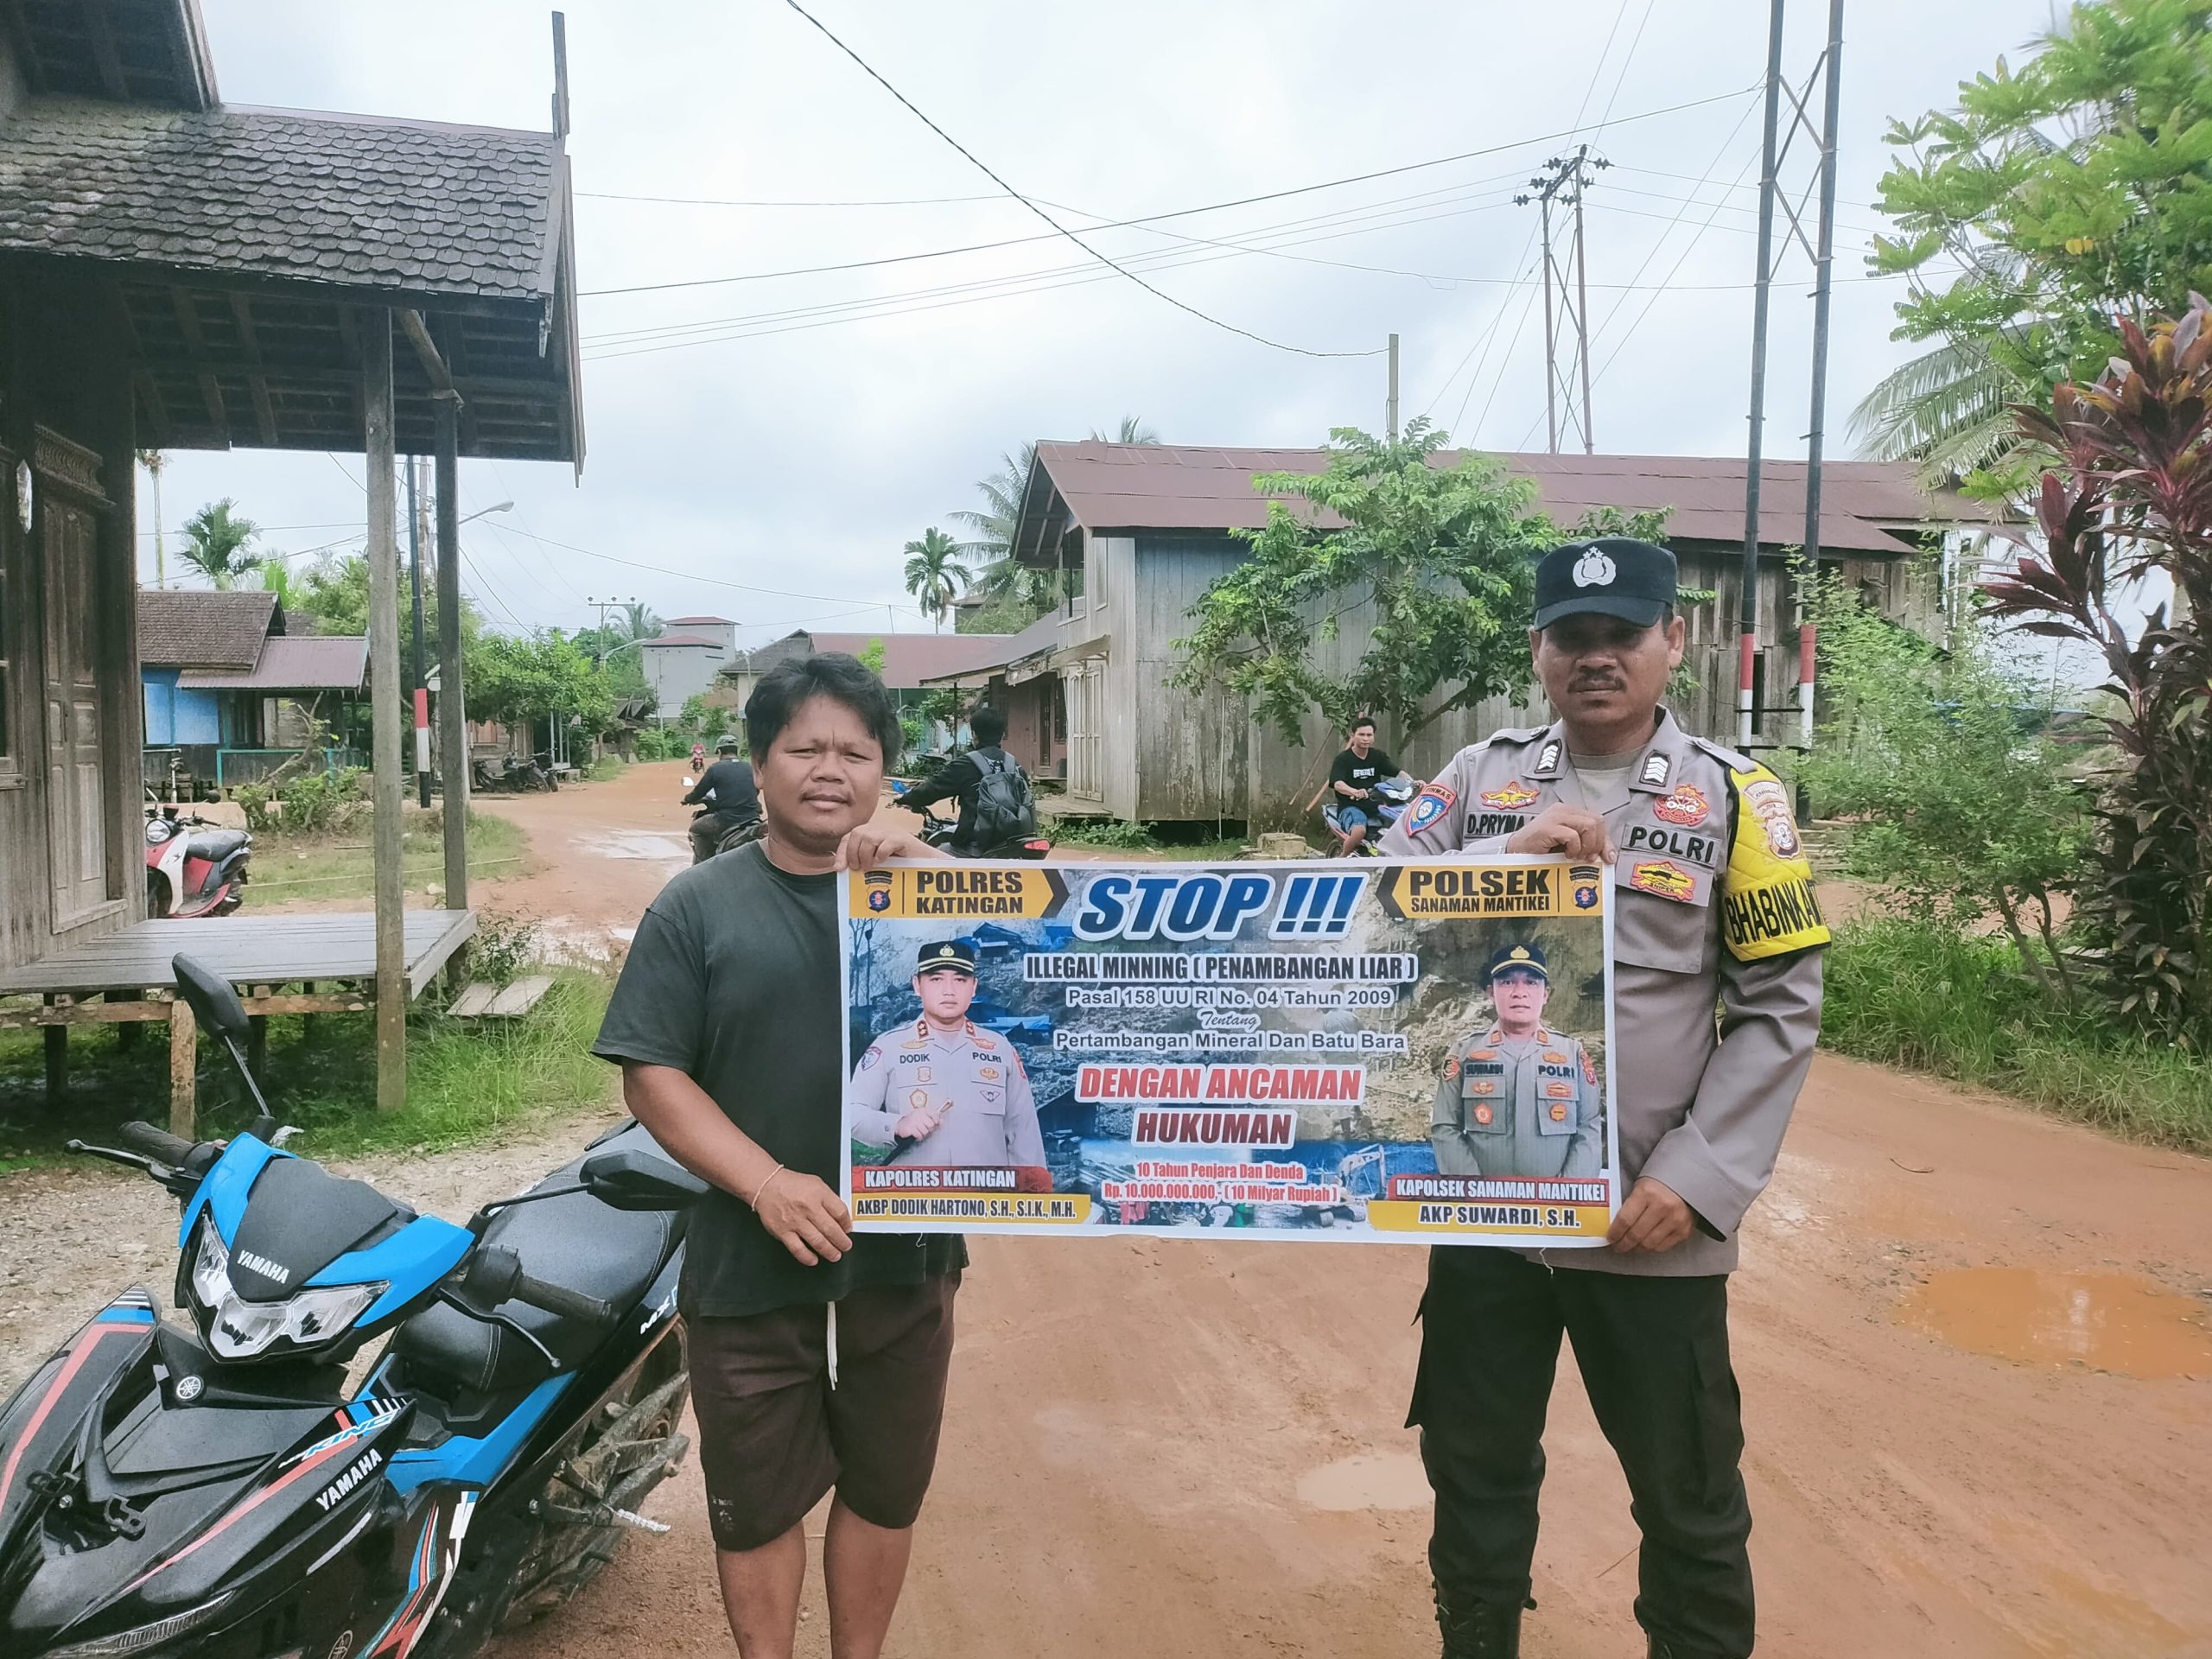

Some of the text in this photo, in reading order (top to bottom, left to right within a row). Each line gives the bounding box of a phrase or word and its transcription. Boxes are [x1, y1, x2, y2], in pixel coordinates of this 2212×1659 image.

[1630, 826, 1714, 862] POLRI
[917, 870, 1023, 893] POLRES
[1409, 869, 1550, 897] POLSEK
[917, 897, 1023, 913] KATINGAN
[1079, 876, 1268, 933] STOP
[1411, 895, 1550, 912] SANAMAN MANTIKEI
[1027, 957, 1097, 979] ILLEGAL
[1103, 957, 1188, 979] MINNING
[1205, 957, 1354, 980] PENAMBANGAN
[1359, 957, 1402, 980] LIAR
[1069, 989, 1391, 1005] Pasal 158 UU RI No. 04 Tahun 2009
[1201, 1010, 1257, 1030] Tentang
[1057, 1033, 1404, 1050] Pertambangan Mineral Dan Batu Bara
[899, 1053, 931, 1064] DODIK
[972, 1052, 1001, 1063] POLRI
[1538, 1065, 1575, 1078] POLRI
[1080, 1068, 1362, 1100] DENGAN ANCAMAN
[1136, 1112, 1292, 1144] HUKUMAN
[865, 1170, 1016, 1188] KAPOLRES KATINGAN
[1137, 1162, 1304, 1179] 10 Tahun Penjara Dan Denda
[1104, 1183, 1122, 1198] Rp.
[1231, 1185, 1244, 1199] 10
[1247, 1185, 1285, 1202] Milyar
[1287, 1185, 1330, 1203] Rupiah
[1396, 1179, 1605, 1201] KAPOLSEK SANAMAN MANTIKEI
[856, 1199, 1076, 1219] AKBP DODIK HARTONO, S.H., S.I.K., M.H.
[1420, 1206, 1580, 1226] AKP SUWARDI, S.H.
[237, 1249, 289, 1284] YAMAHA
[315, 1448, 383, 1511] YAMAHA
